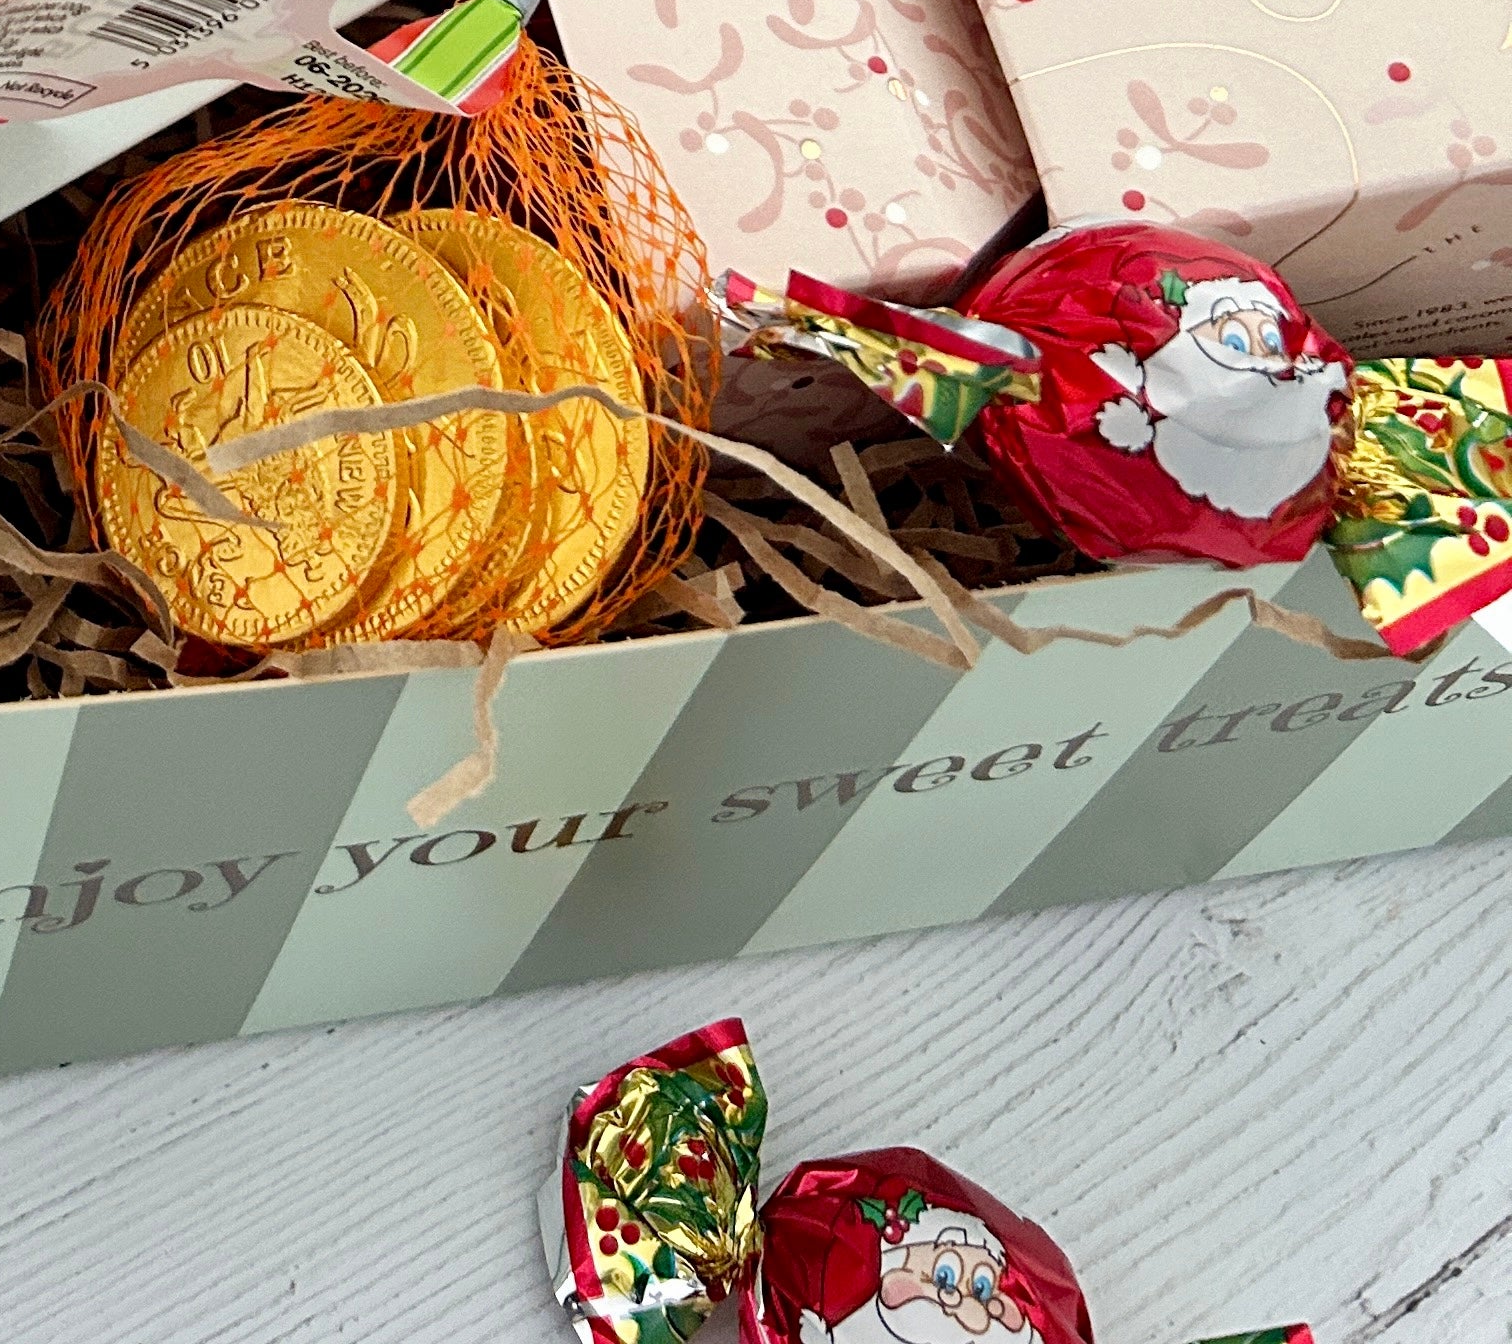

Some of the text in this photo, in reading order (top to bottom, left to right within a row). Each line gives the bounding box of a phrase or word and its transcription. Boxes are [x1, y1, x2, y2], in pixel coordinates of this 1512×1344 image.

[130, 58, 150, 70] 5
[313, 797, 670, 895] your
[710, 720, 1114, 826] sweet
[1157, 655, 1512, 754] treats
